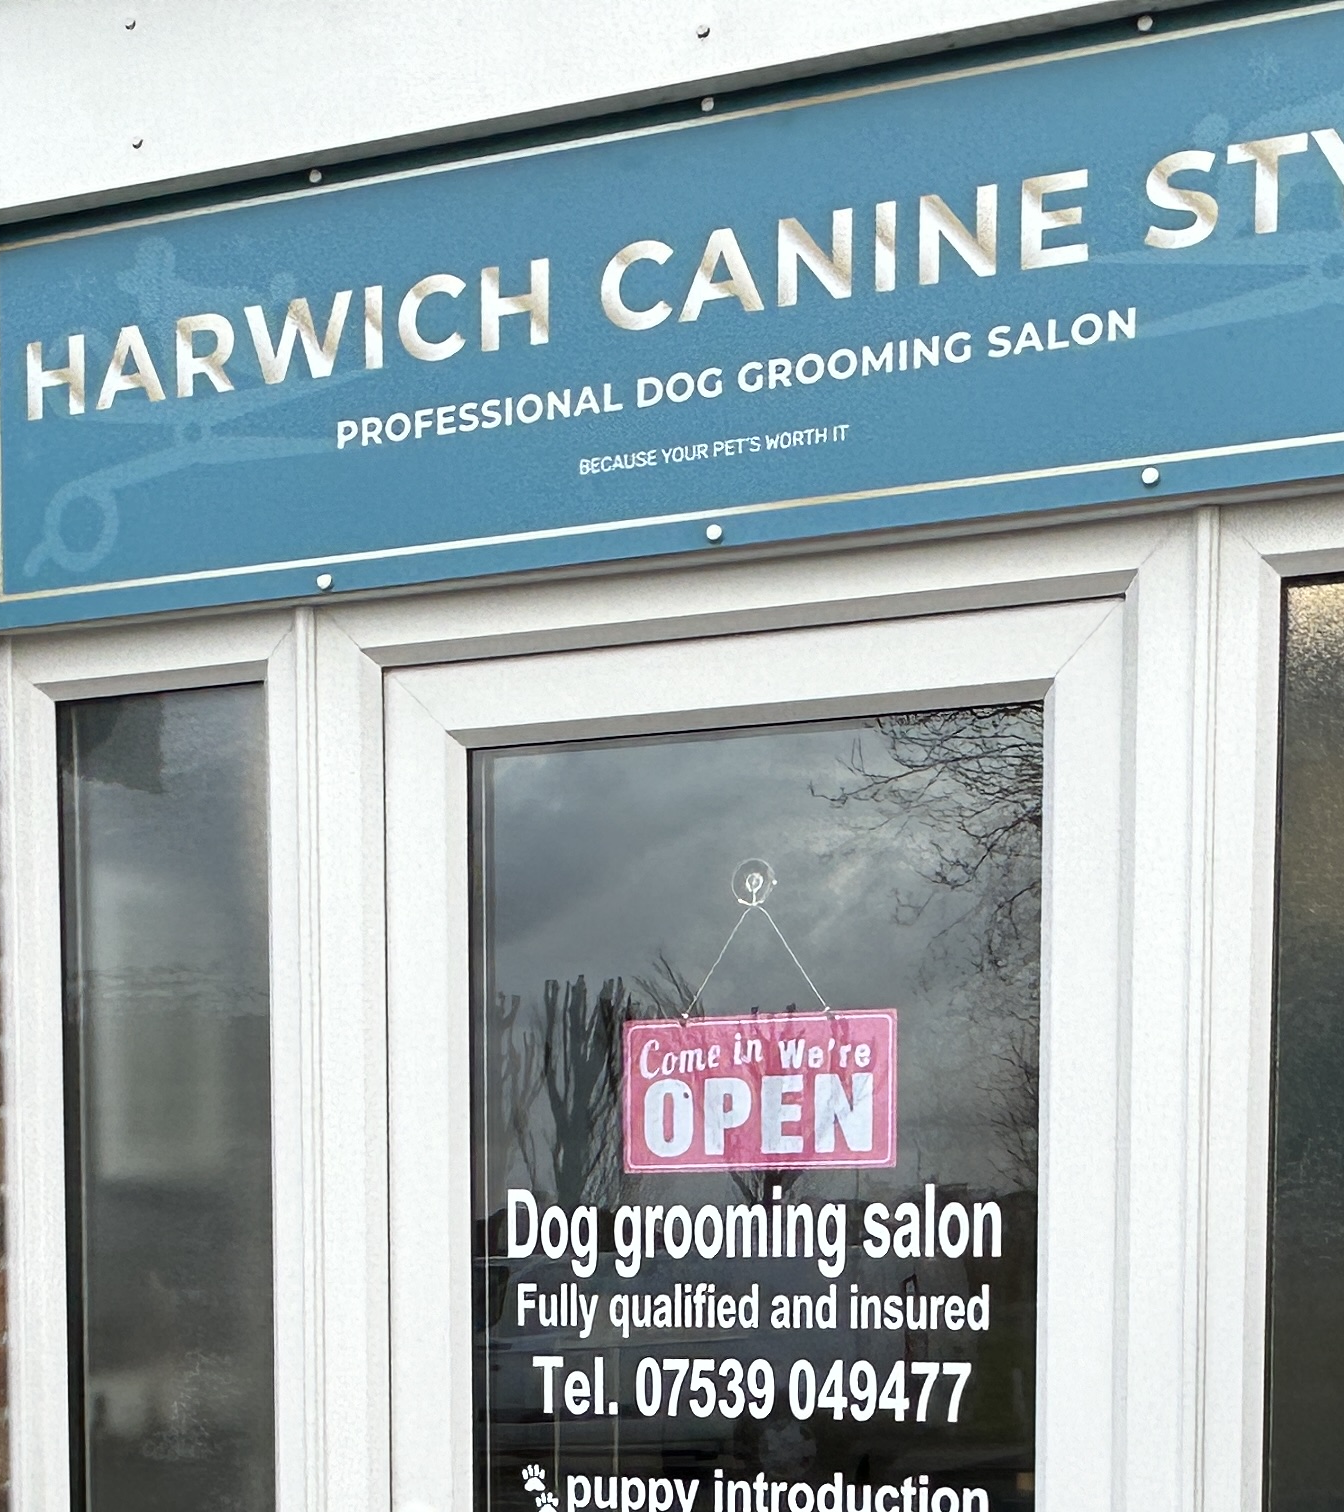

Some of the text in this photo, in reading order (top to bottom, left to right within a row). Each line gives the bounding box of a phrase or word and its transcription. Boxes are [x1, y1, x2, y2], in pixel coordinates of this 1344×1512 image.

[27, 258, 550, 420] HARWICH
[601, 169, 1089, 331] CANINE
[336, 307, 1137, 450] PROFESSIONAL DOG GROOMING SALON
[579, 424, 851, 476] BECAUSE YOUR PET'S WORTH IT
[639, 1032, 872, 1080] Come in We're
[644, 1072, 874, 1158] OPEN
[508, 1184, 1002, 1279] Dog grooming salon
[517, 1282, 990, 1339] Fully qualified and insured
[532, 1356, 972, 1423] Tel. 07539 049477
